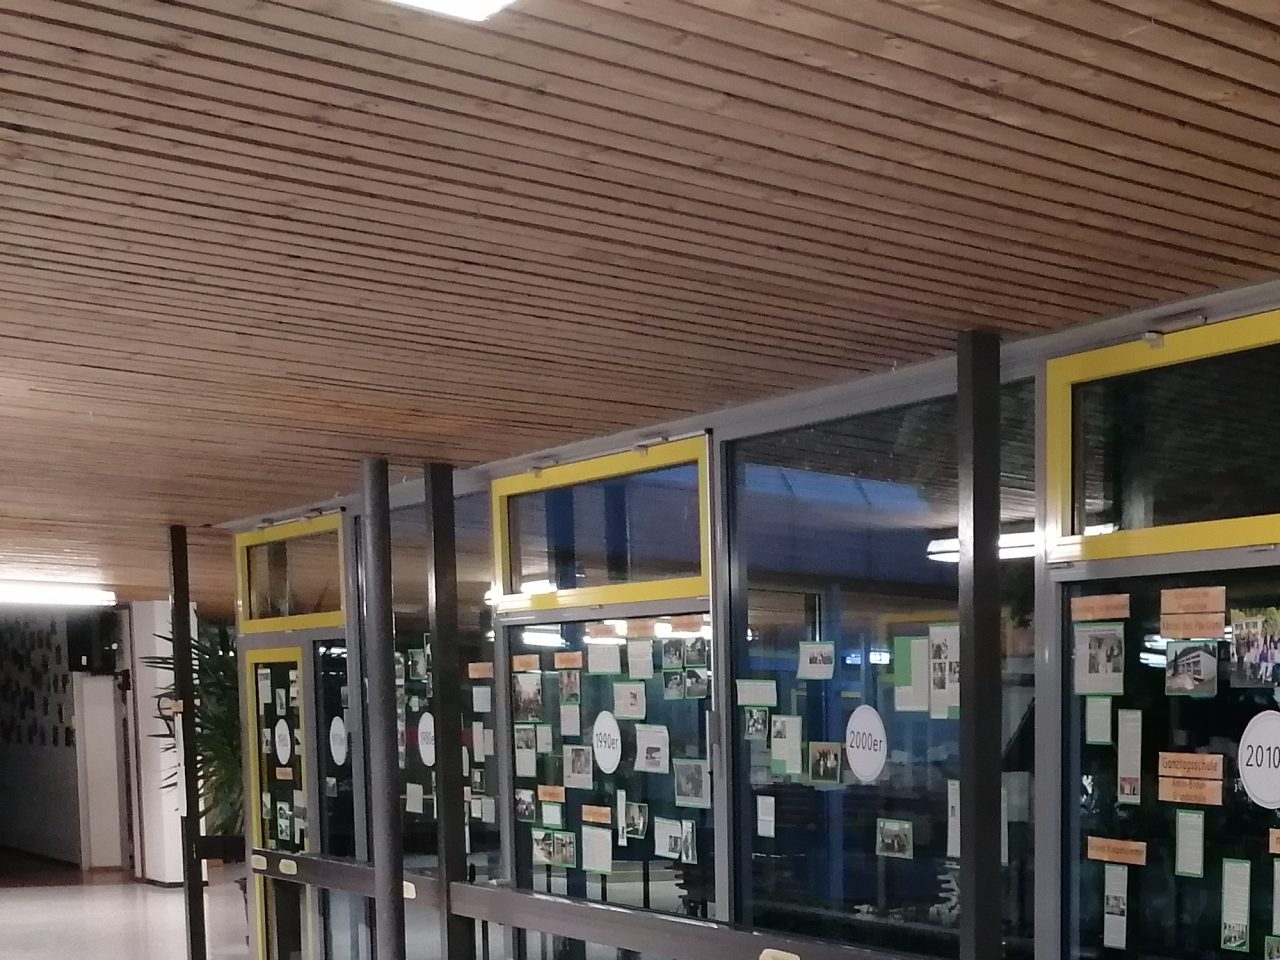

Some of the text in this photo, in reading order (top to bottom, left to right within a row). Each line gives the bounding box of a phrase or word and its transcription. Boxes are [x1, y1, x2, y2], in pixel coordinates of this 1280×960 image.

[595, 732, 619, 751] 1990er
[848, 730, 883, 753] 2000er
[1162, 756, 1218, 773] Ganztagsschule
